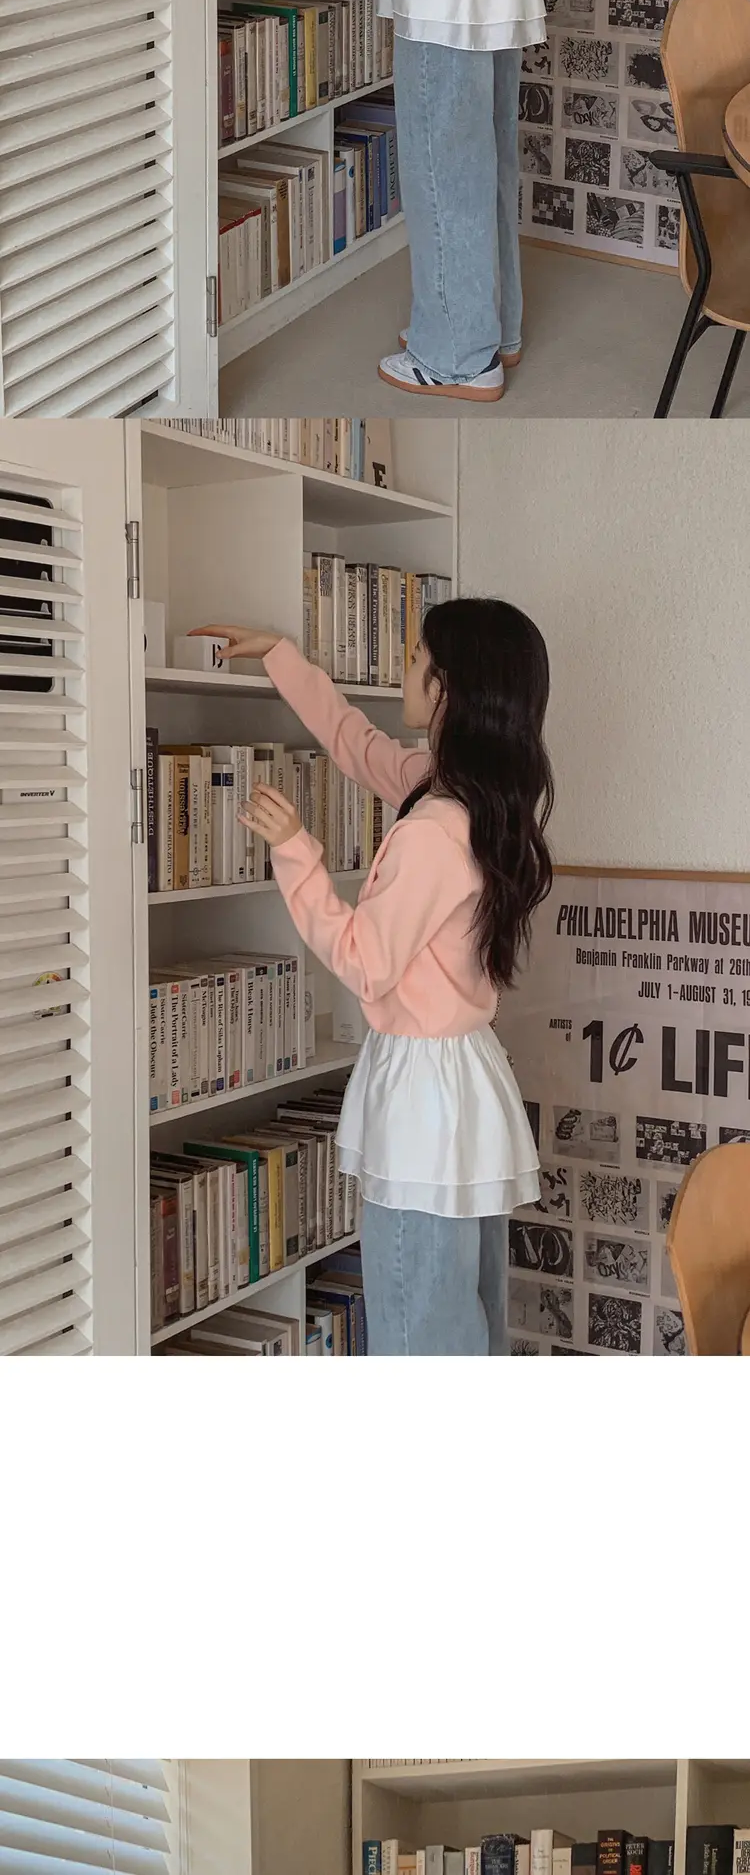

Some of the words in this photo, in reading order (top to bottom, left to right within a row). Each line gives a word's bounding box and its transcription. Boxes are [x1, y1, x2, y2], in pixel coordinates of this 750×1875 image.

[388, 138, 396, 201] HACHETTE
[372, 461, 387, 490] E
[49, 789, 55, 797] V
[177, 777, 189, 836] Aggression
[556, 904, 679, 942] PHILADELPHIA
[576, 947, 617, 967] Benjamin
[622, 951, 662, 970] Franklin
[667, 953, 709, 974] Parkway
[715, 957, 724, 974] at
[171, 995, 179, 1013] The
[638, 981, 661, 999] JULY
[667, 984, 717, 1004] 1-AUGUST
[723, 988, 737, 1007] 31,
[171, 1013, 179, 1050] Portrait
[549, 1018, 572, 1029] ARTISTS
[565, 1032, 572, 1042] of
[171, 1050, 179, 1059] of
[582, 1020, 644, 1083] 1¢
[662, 1026, 750, 1100] LIF
[170, 1065, 179, 1088] Lady
